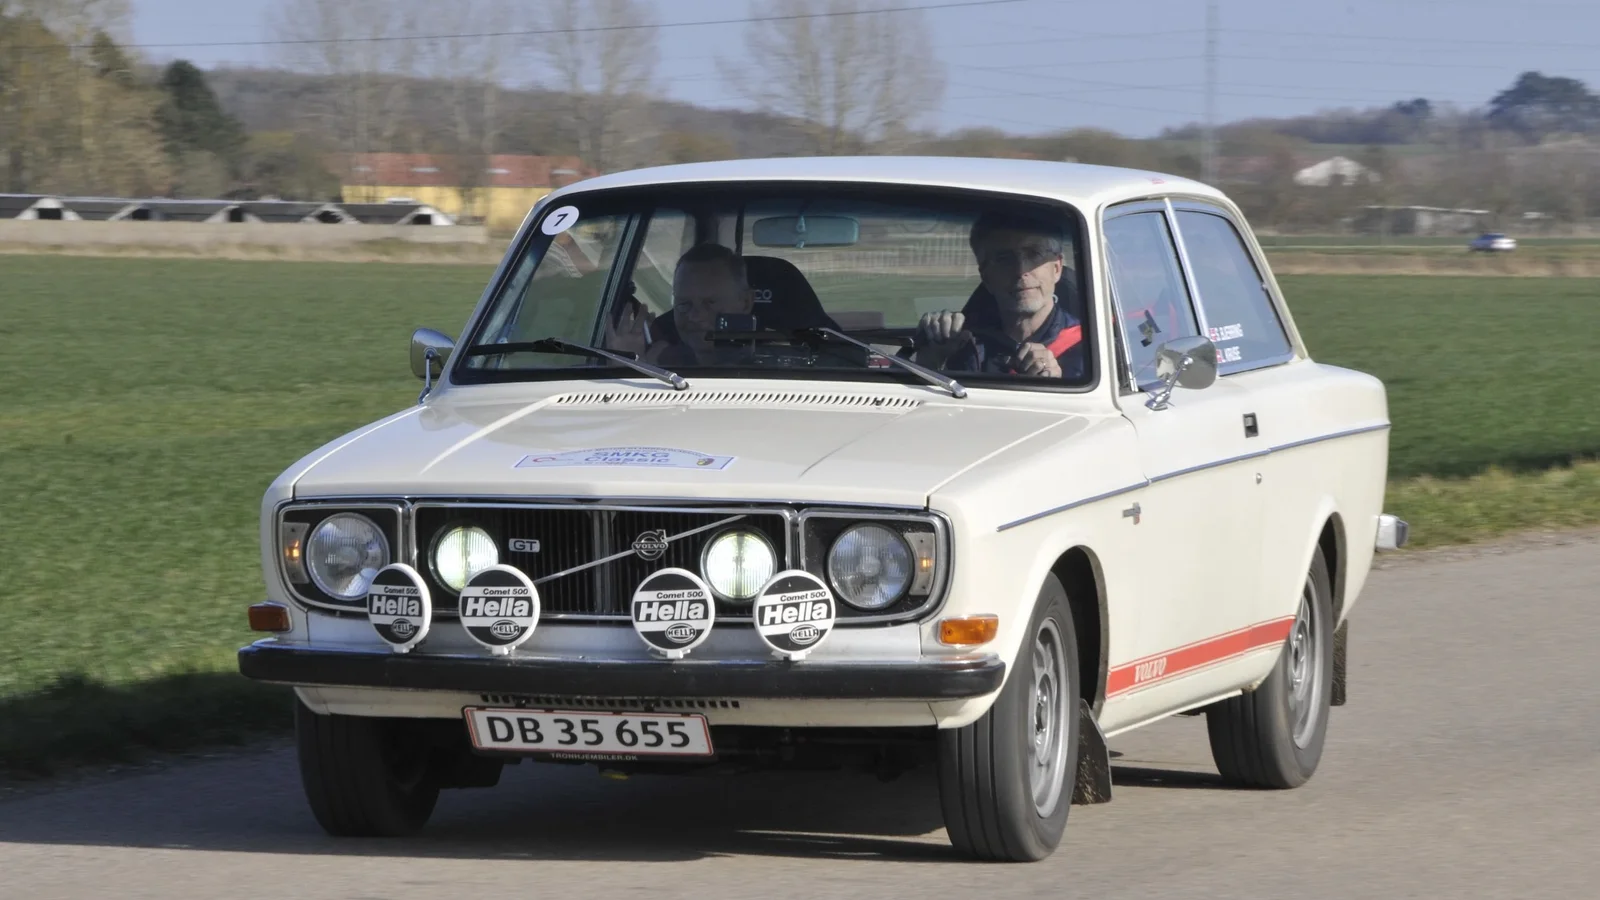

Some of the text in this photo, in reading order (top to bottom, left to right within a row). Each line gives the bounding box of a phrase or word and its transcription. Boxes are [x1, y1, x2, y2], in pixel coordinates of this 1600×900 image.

[553, 213, 569, 227] 7
[513, 540, 537, 551] GT
[384, 586, 418, 595] Comet 500
[687, 590, 704, 598] 500
[780, 591, 827, 602] Comet 500
[372, 595, 420, 616] Hella
[465, 597, 530, 617] Hella
[638, 601, 705, 621] Hella
[763, 603, 828, 626] Hella
[392, 623, 415, 633] HELLA
[492, 625, 520, 634] HELLA
[668, 628, 696, 637] HELLA
[791, 629, 820, 639] HELLA
[1134, 656, 1167, 683] VOLVO
[486, 716, 690, 748] DB 35 655
